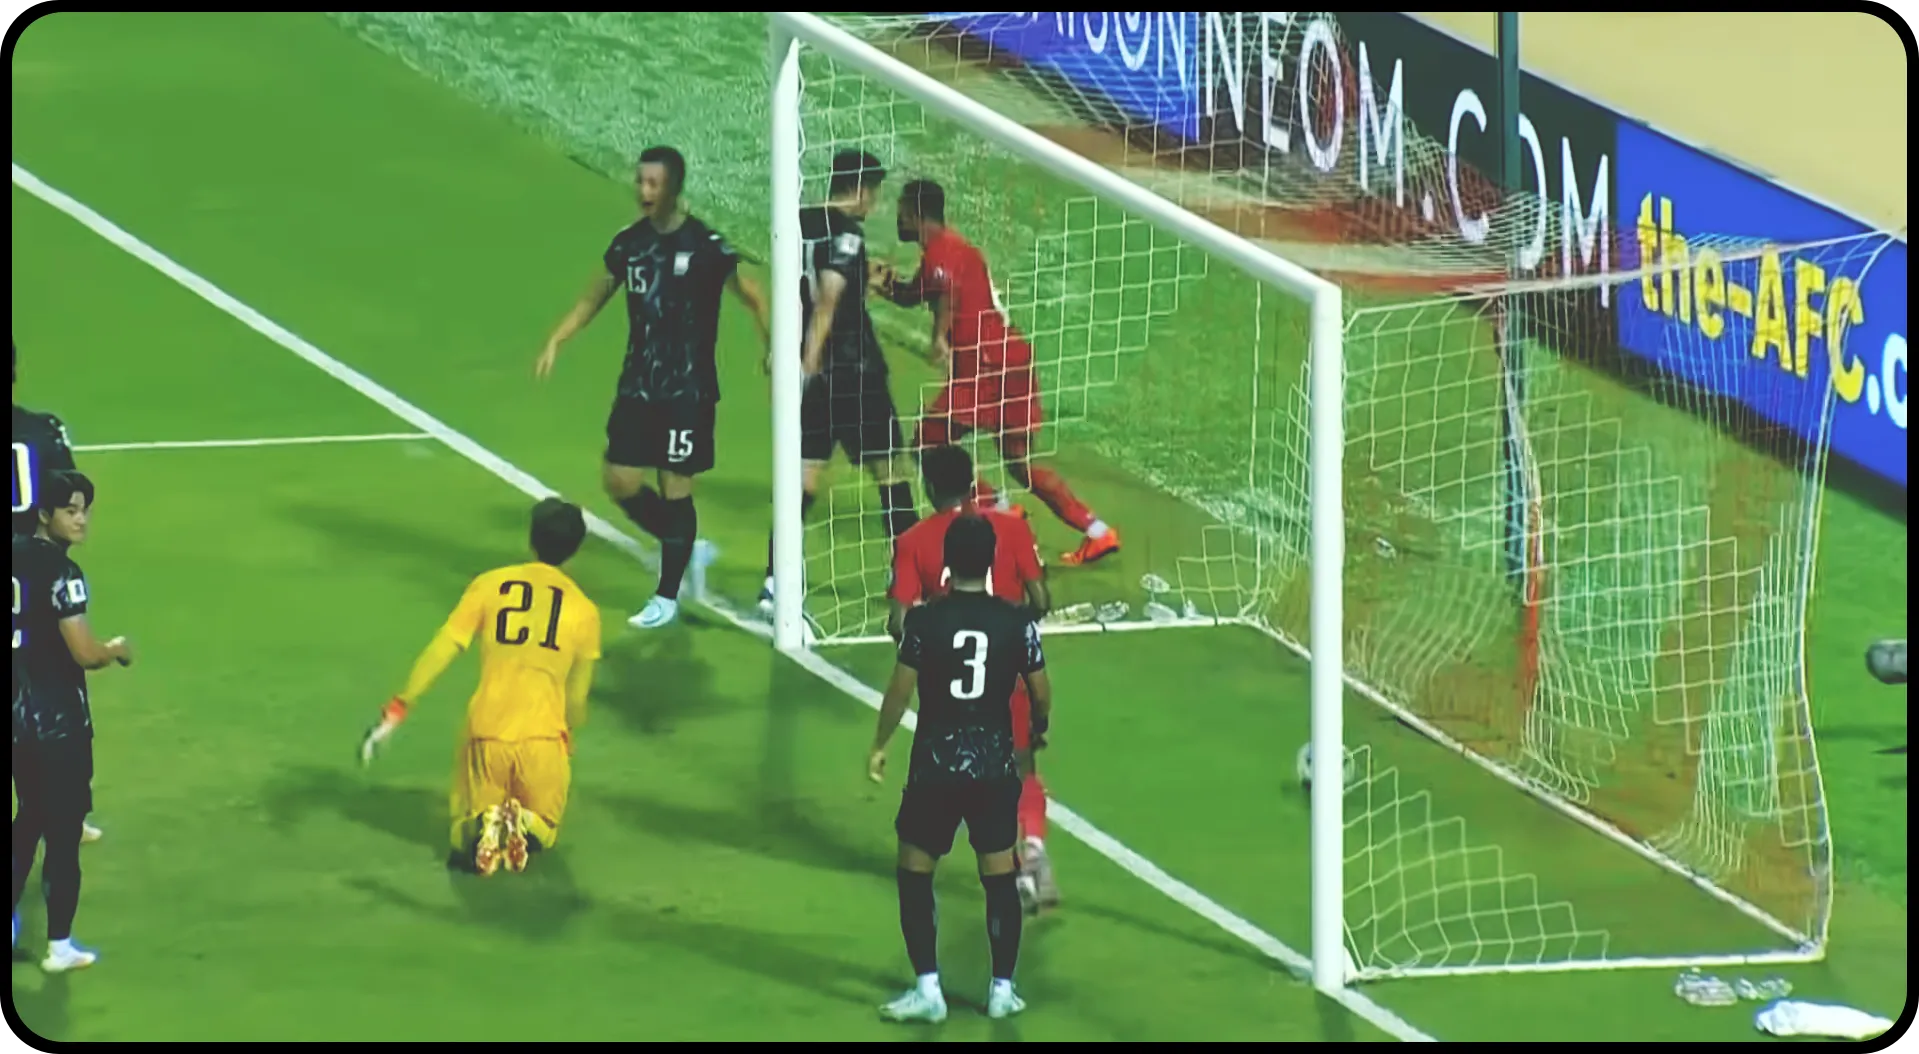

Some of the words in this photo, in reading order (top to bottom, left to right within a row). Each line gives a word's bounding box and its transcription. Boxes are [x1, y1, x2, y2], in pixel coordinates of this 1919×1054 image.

[627, 265, 647, 293] 15
[667, 429, 694, 457] 15
[496, 580, 564, 651] 21
[950, 630, 989, 699] 3
